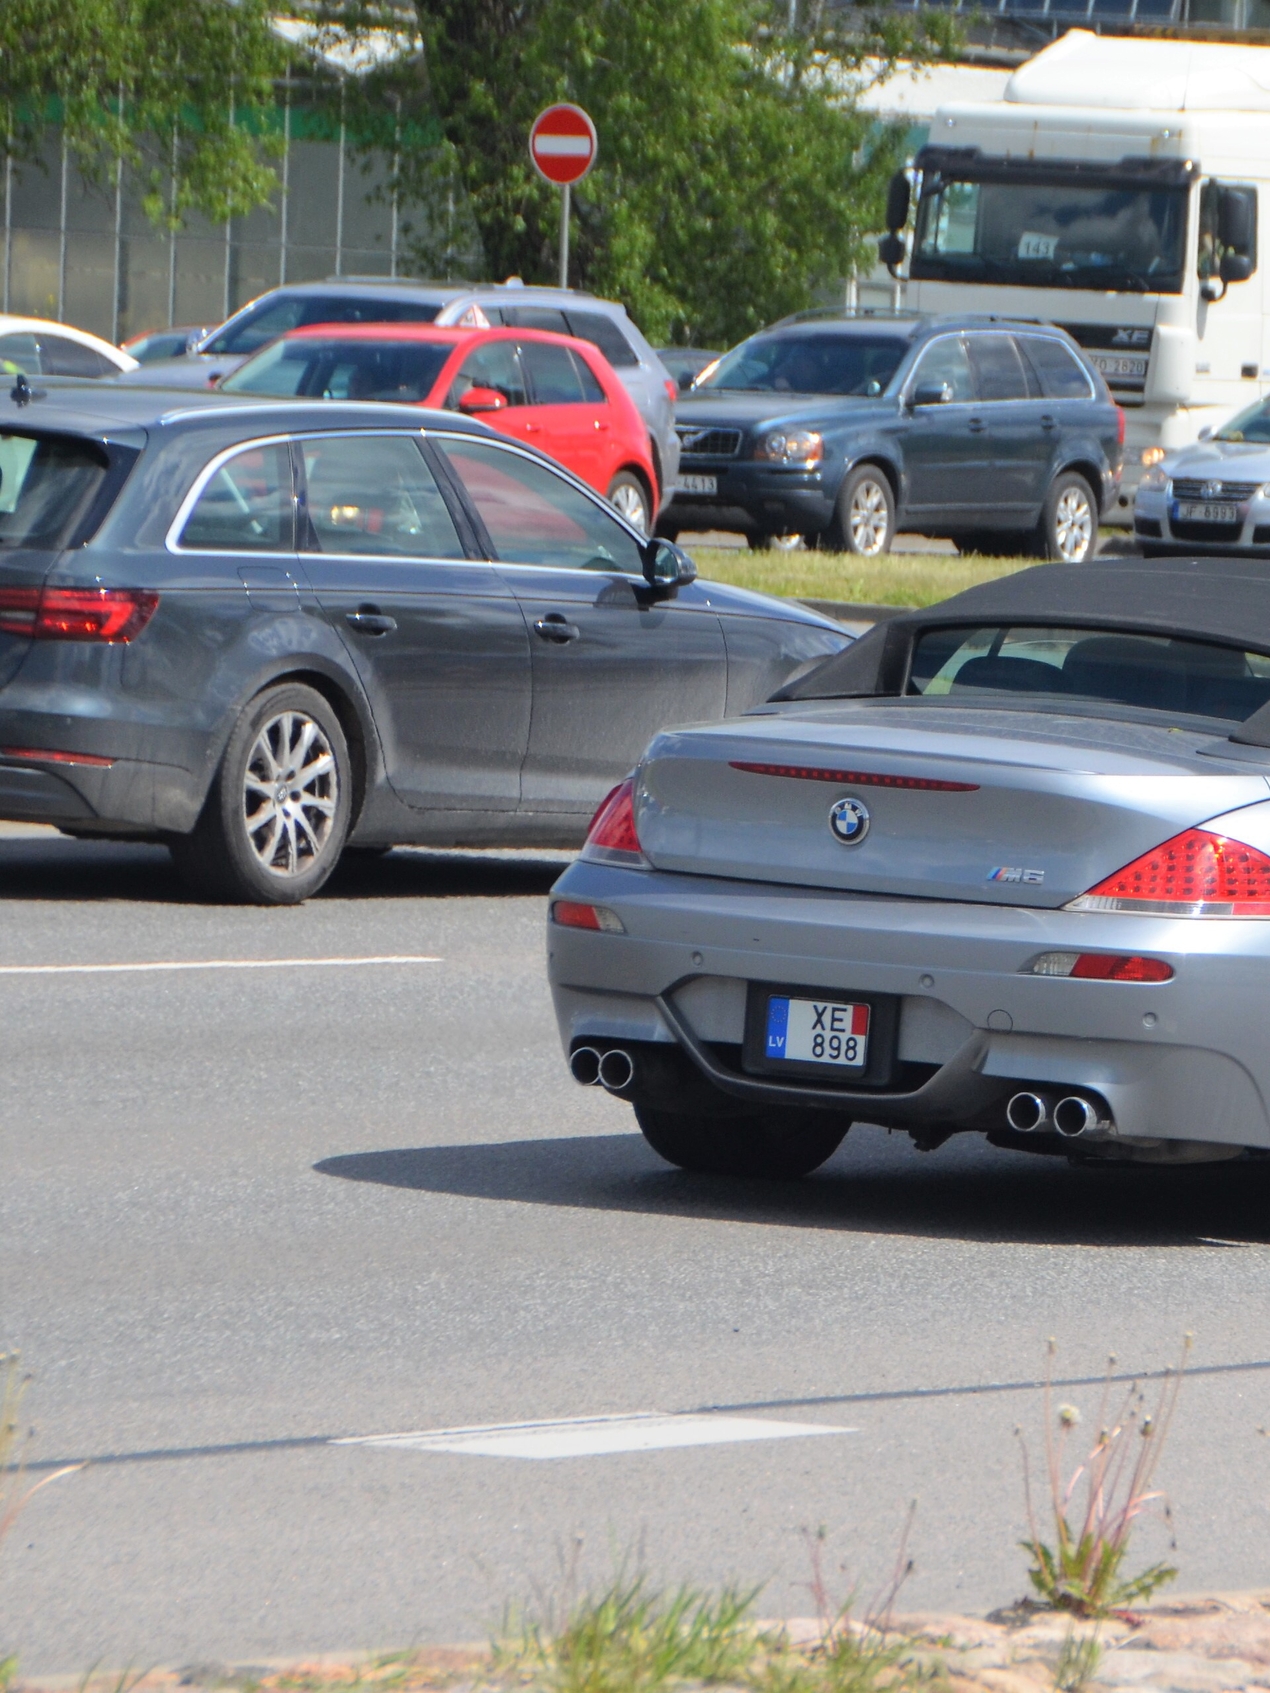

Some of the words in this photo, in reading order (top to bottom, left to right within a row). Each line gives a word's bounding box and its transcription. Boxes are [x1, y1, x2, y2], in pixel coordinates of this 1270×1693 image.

[811, 1004, 847, 1033] XE
[768, 1035, 785, 1048] LV
[812, 1033, 858, 1062] 898
